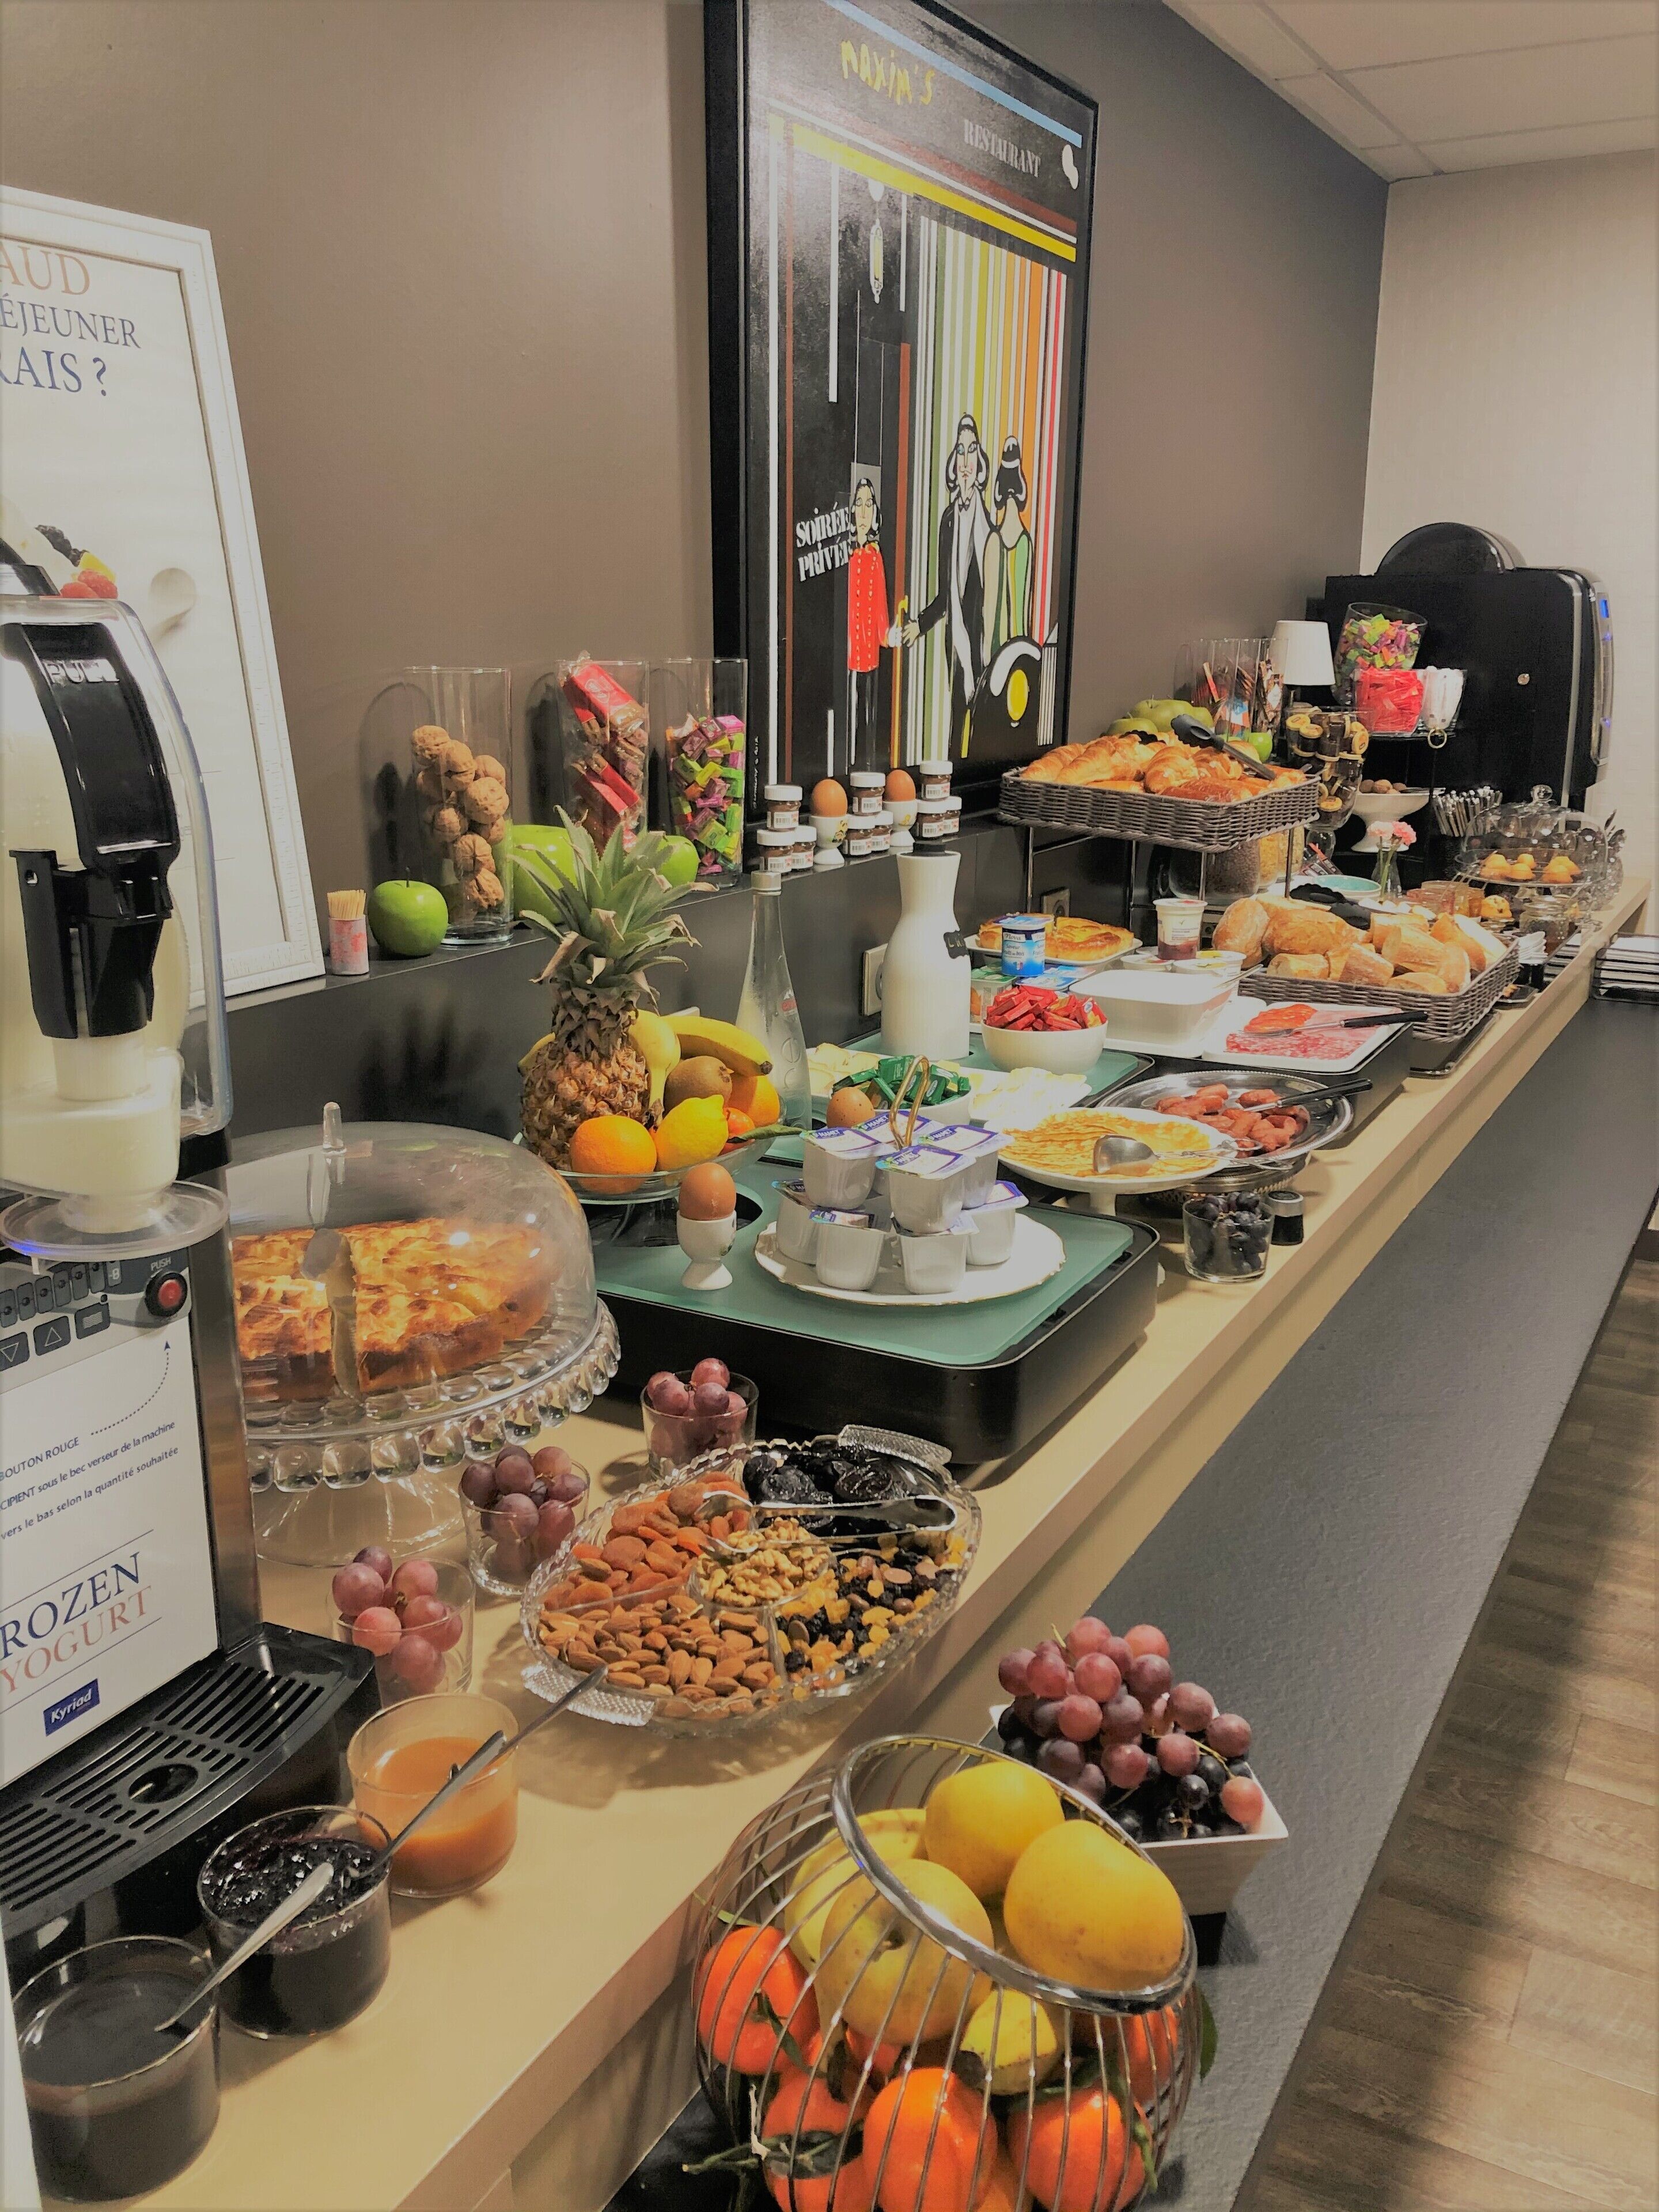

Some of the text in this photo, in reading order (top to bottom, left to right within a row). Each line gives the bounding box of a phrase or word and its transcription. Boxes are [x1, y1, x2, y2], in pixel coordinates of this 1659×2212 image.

[964, 118, 1042, 177] RESTAURANT
[1004, 933, 1021, 941] Nova
[151, 1256, 171, 1271] PUSH
[0, 1421, 175, 1510] CIPIENT sous le bec verseur de la machine
[46, 1437, 79, 1460] ROUGE
[1, 1446, 179, 1540] vers le bas selon la quantité souhaitée
[0, 1551, 140, 1660] ROZEN
[0, 1585, 152, 1694] YOGURT
[51, 1688, 92, 1724] Kyriad
